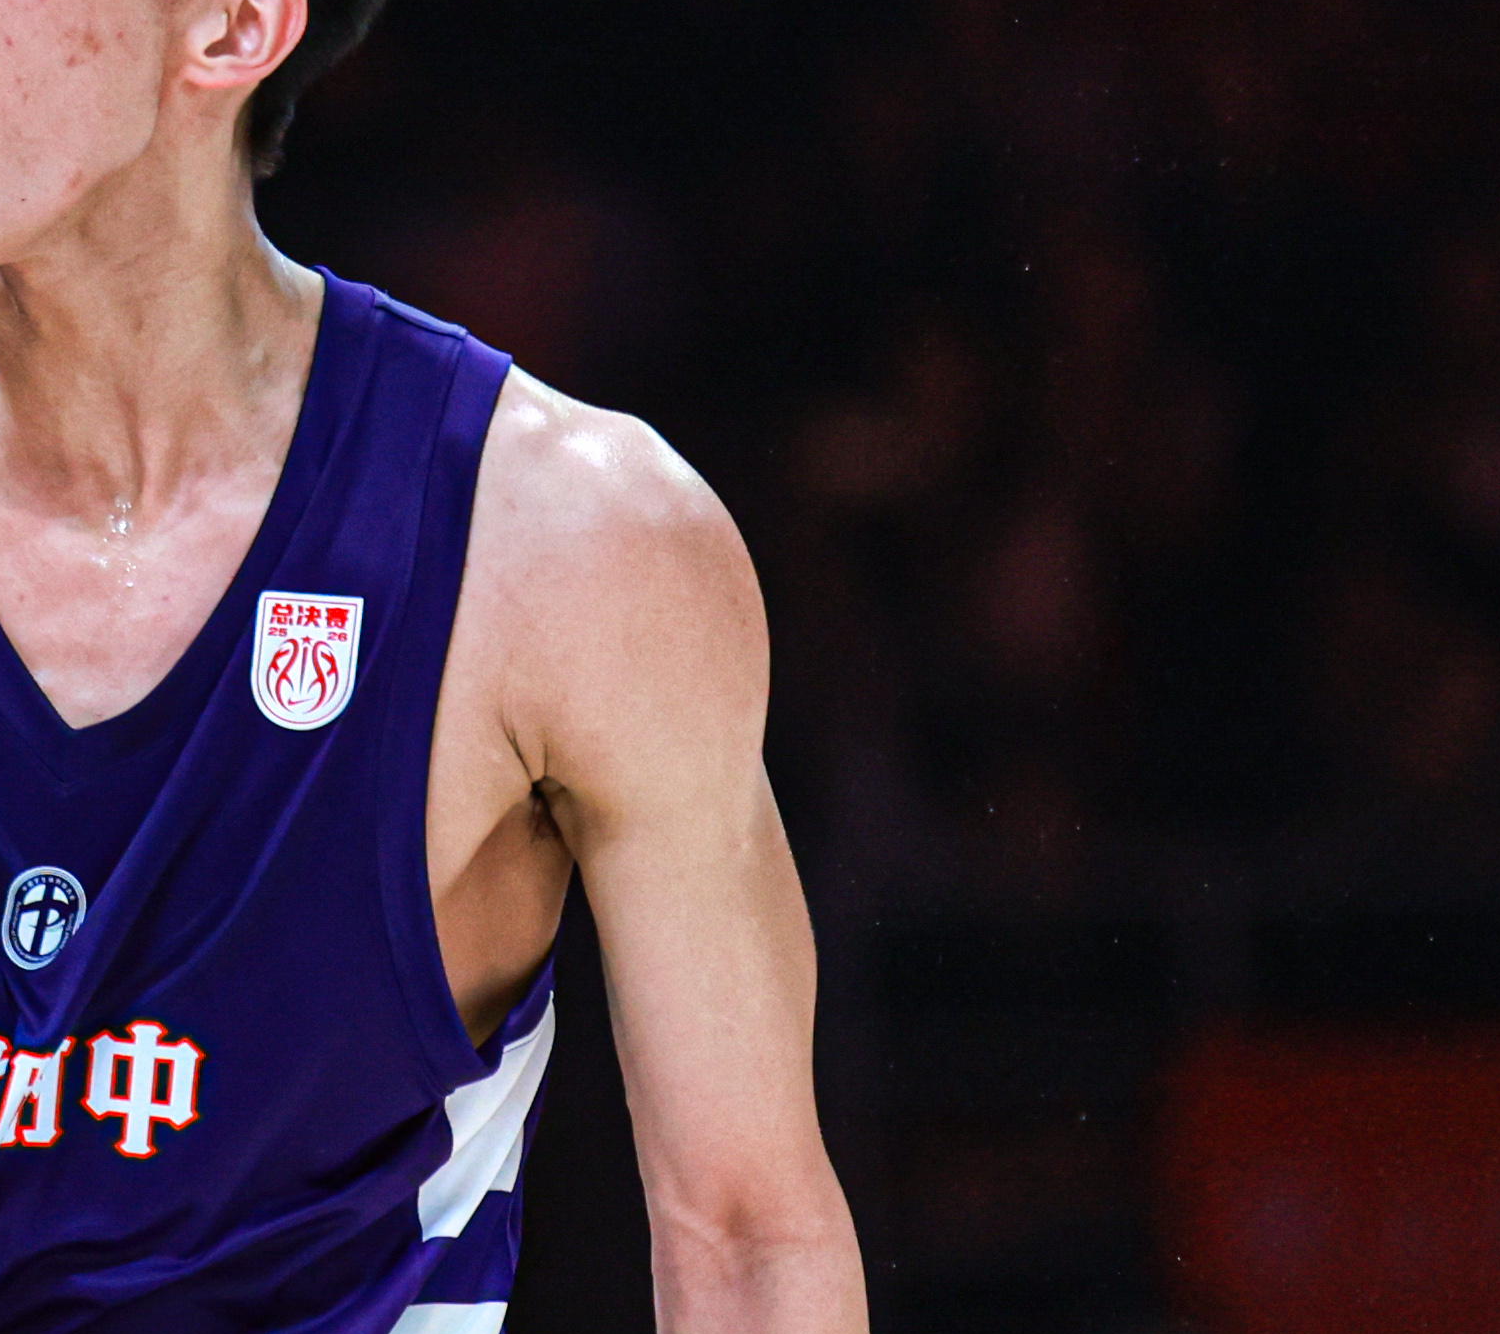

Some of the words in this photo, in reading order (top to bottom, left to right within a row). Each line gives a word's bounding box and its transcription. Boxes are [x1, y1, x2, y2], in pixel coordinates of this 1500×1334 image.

[269, 602, 349, 629] 总决赛
[268, 627, 288, 637] 25
[327, 631, 348, 642] 26
